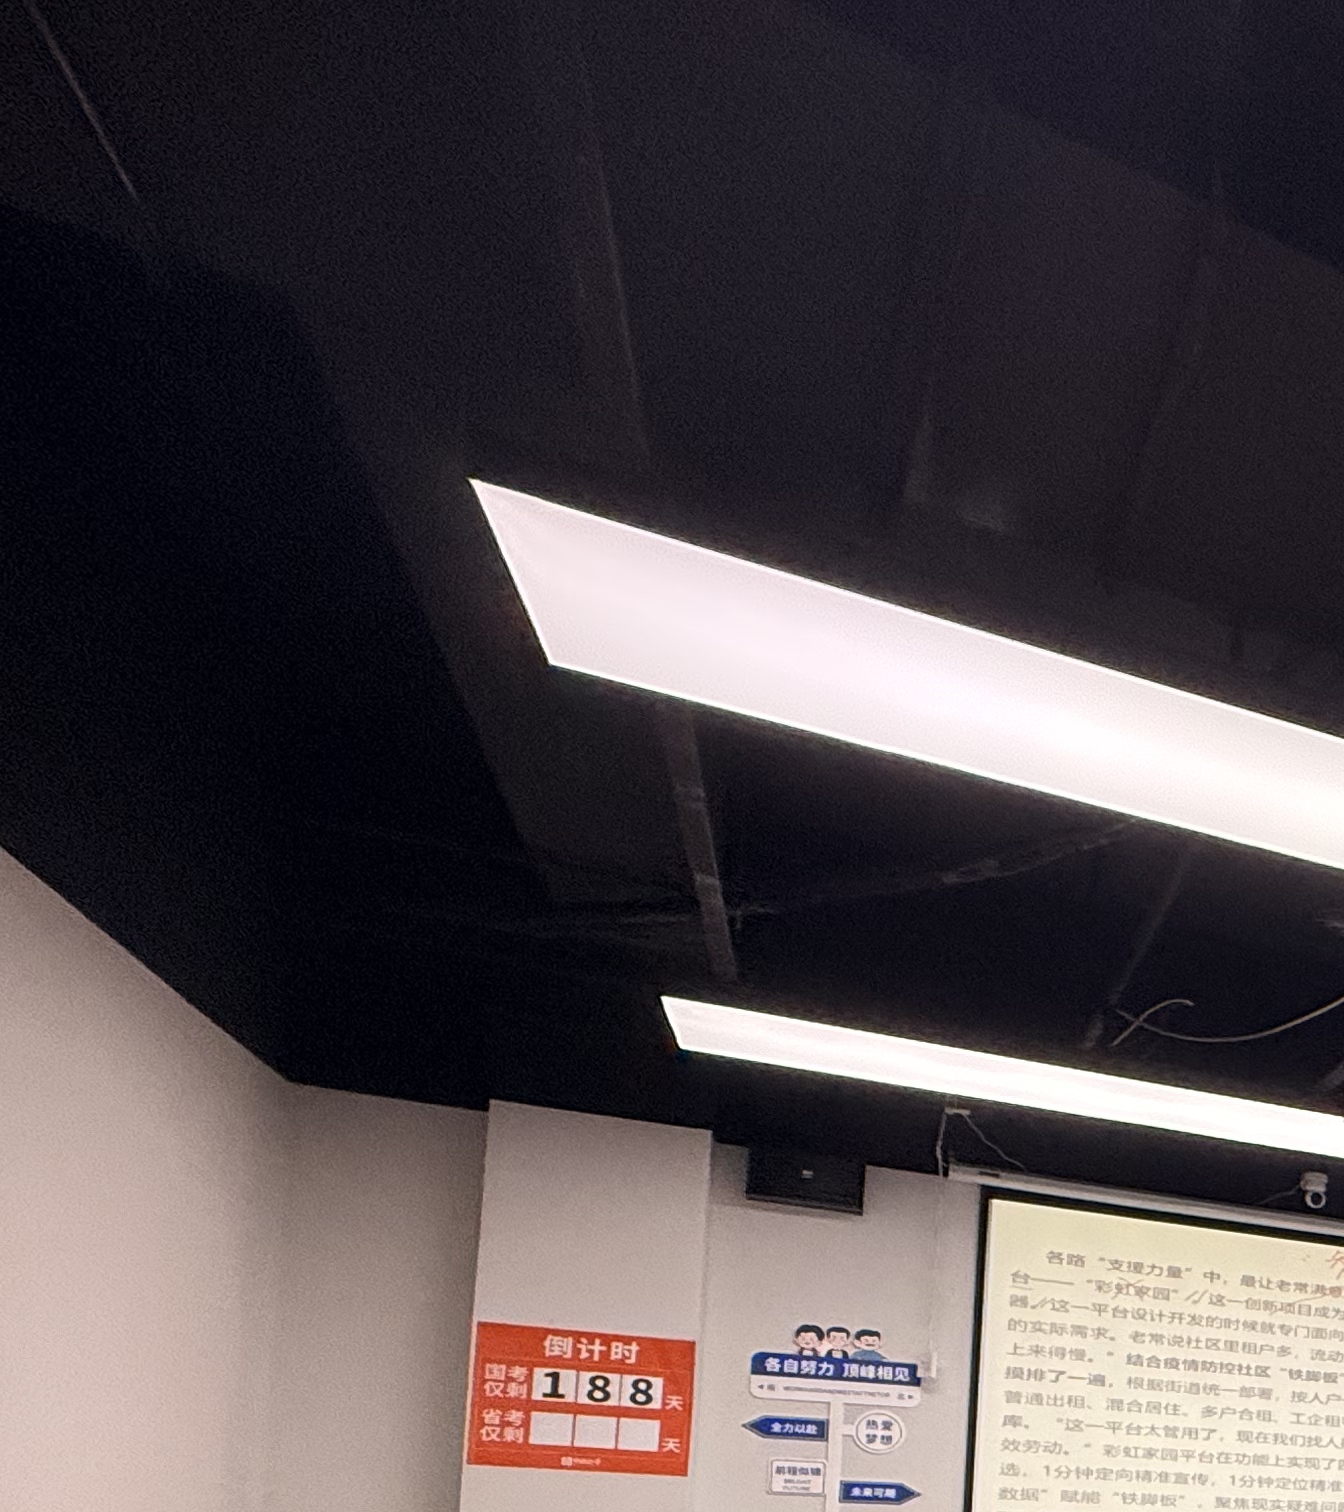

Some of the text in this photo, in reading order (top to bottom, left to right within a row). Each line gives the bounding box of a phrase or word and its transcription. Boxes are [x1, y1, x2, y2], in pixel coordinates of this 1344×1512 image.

[543, 1334, 640, 1364] 倒计时
[484, 1363, 529, 1382] 国考
[765, 1357, 911, 1382] 各自努力 顶峰相见
[484, 1381, 528, 1399] 仅剩
[542, 1371, 653, 1406] 188
[665, 1395, 683, 1411] 天
[482, 1409, 526, 1426] 省考
[480, 1426, 524, 1444] 仅剩
[662, 1438, 680, 1454] 天
